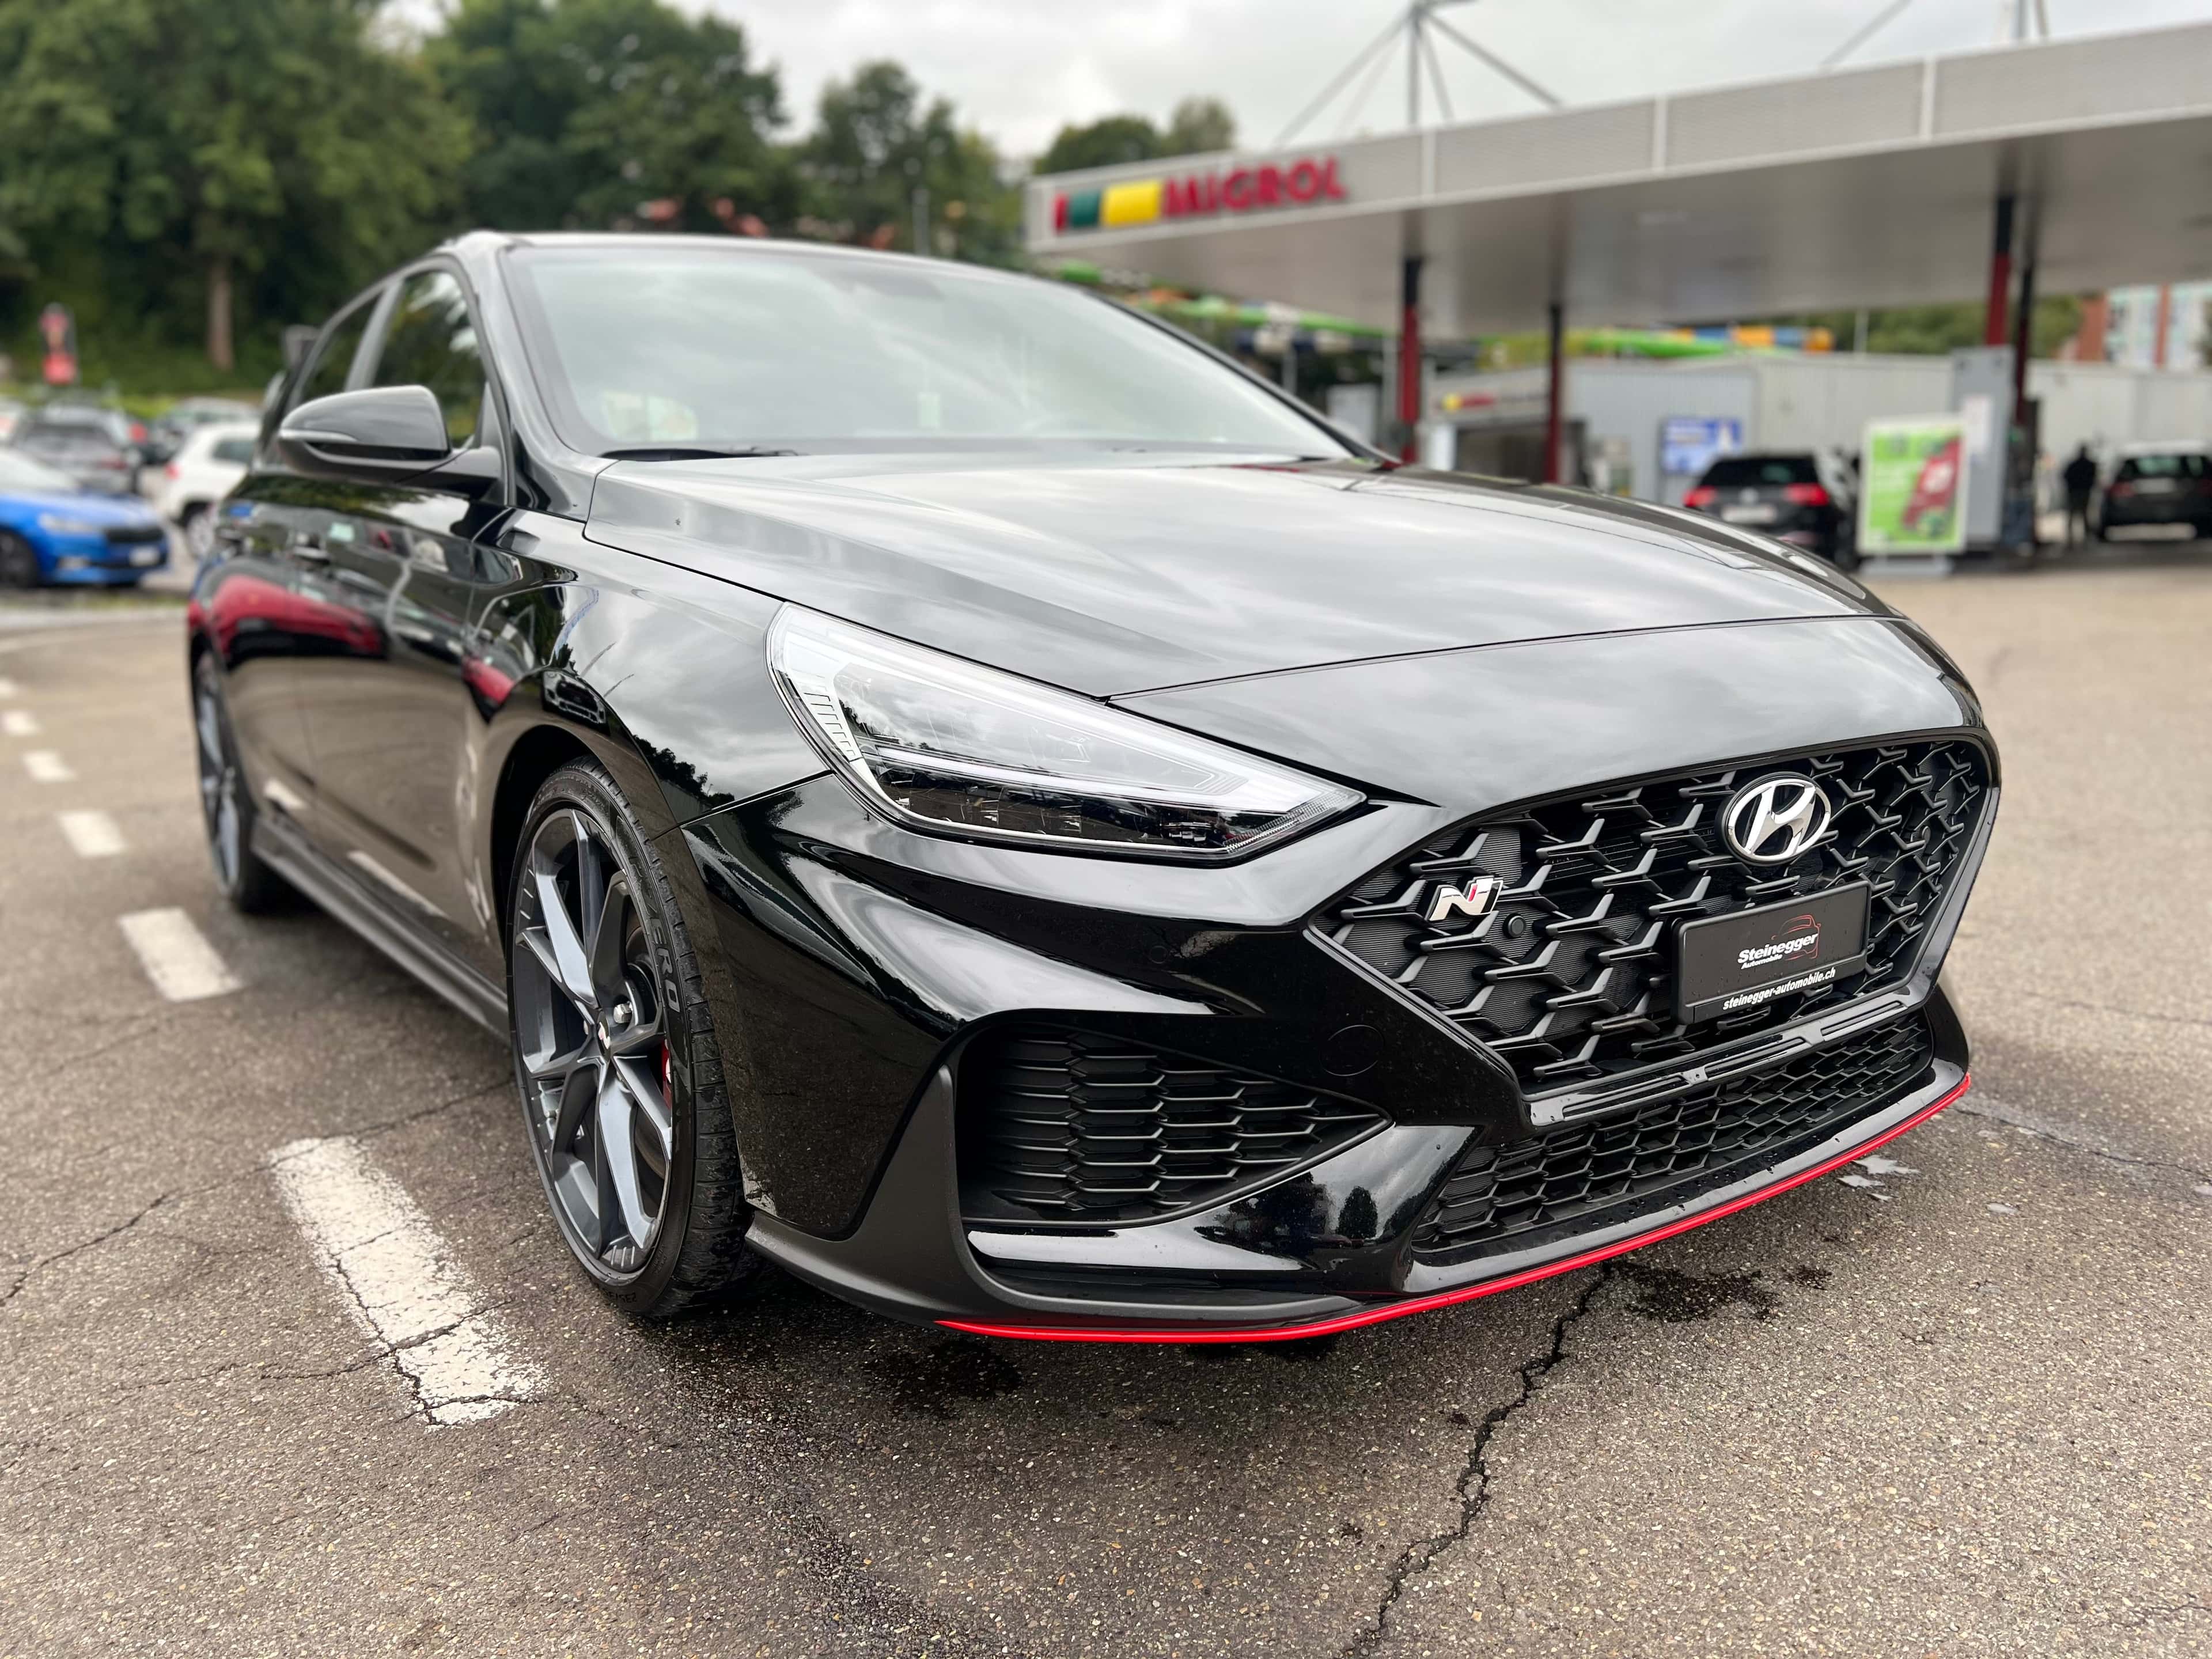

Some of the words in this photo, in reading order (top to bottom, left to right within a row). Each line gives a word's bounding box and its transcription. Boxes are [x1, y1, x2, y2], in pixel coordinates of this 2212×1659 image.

[1163, 158, 1347, 219] MIGROL
[1737, 933, 1819, 964] Steinegger
[1741, 953, 1783, 969] Automobile
[1722, 967, 1836, 1010] steinegger-automobile.ch
